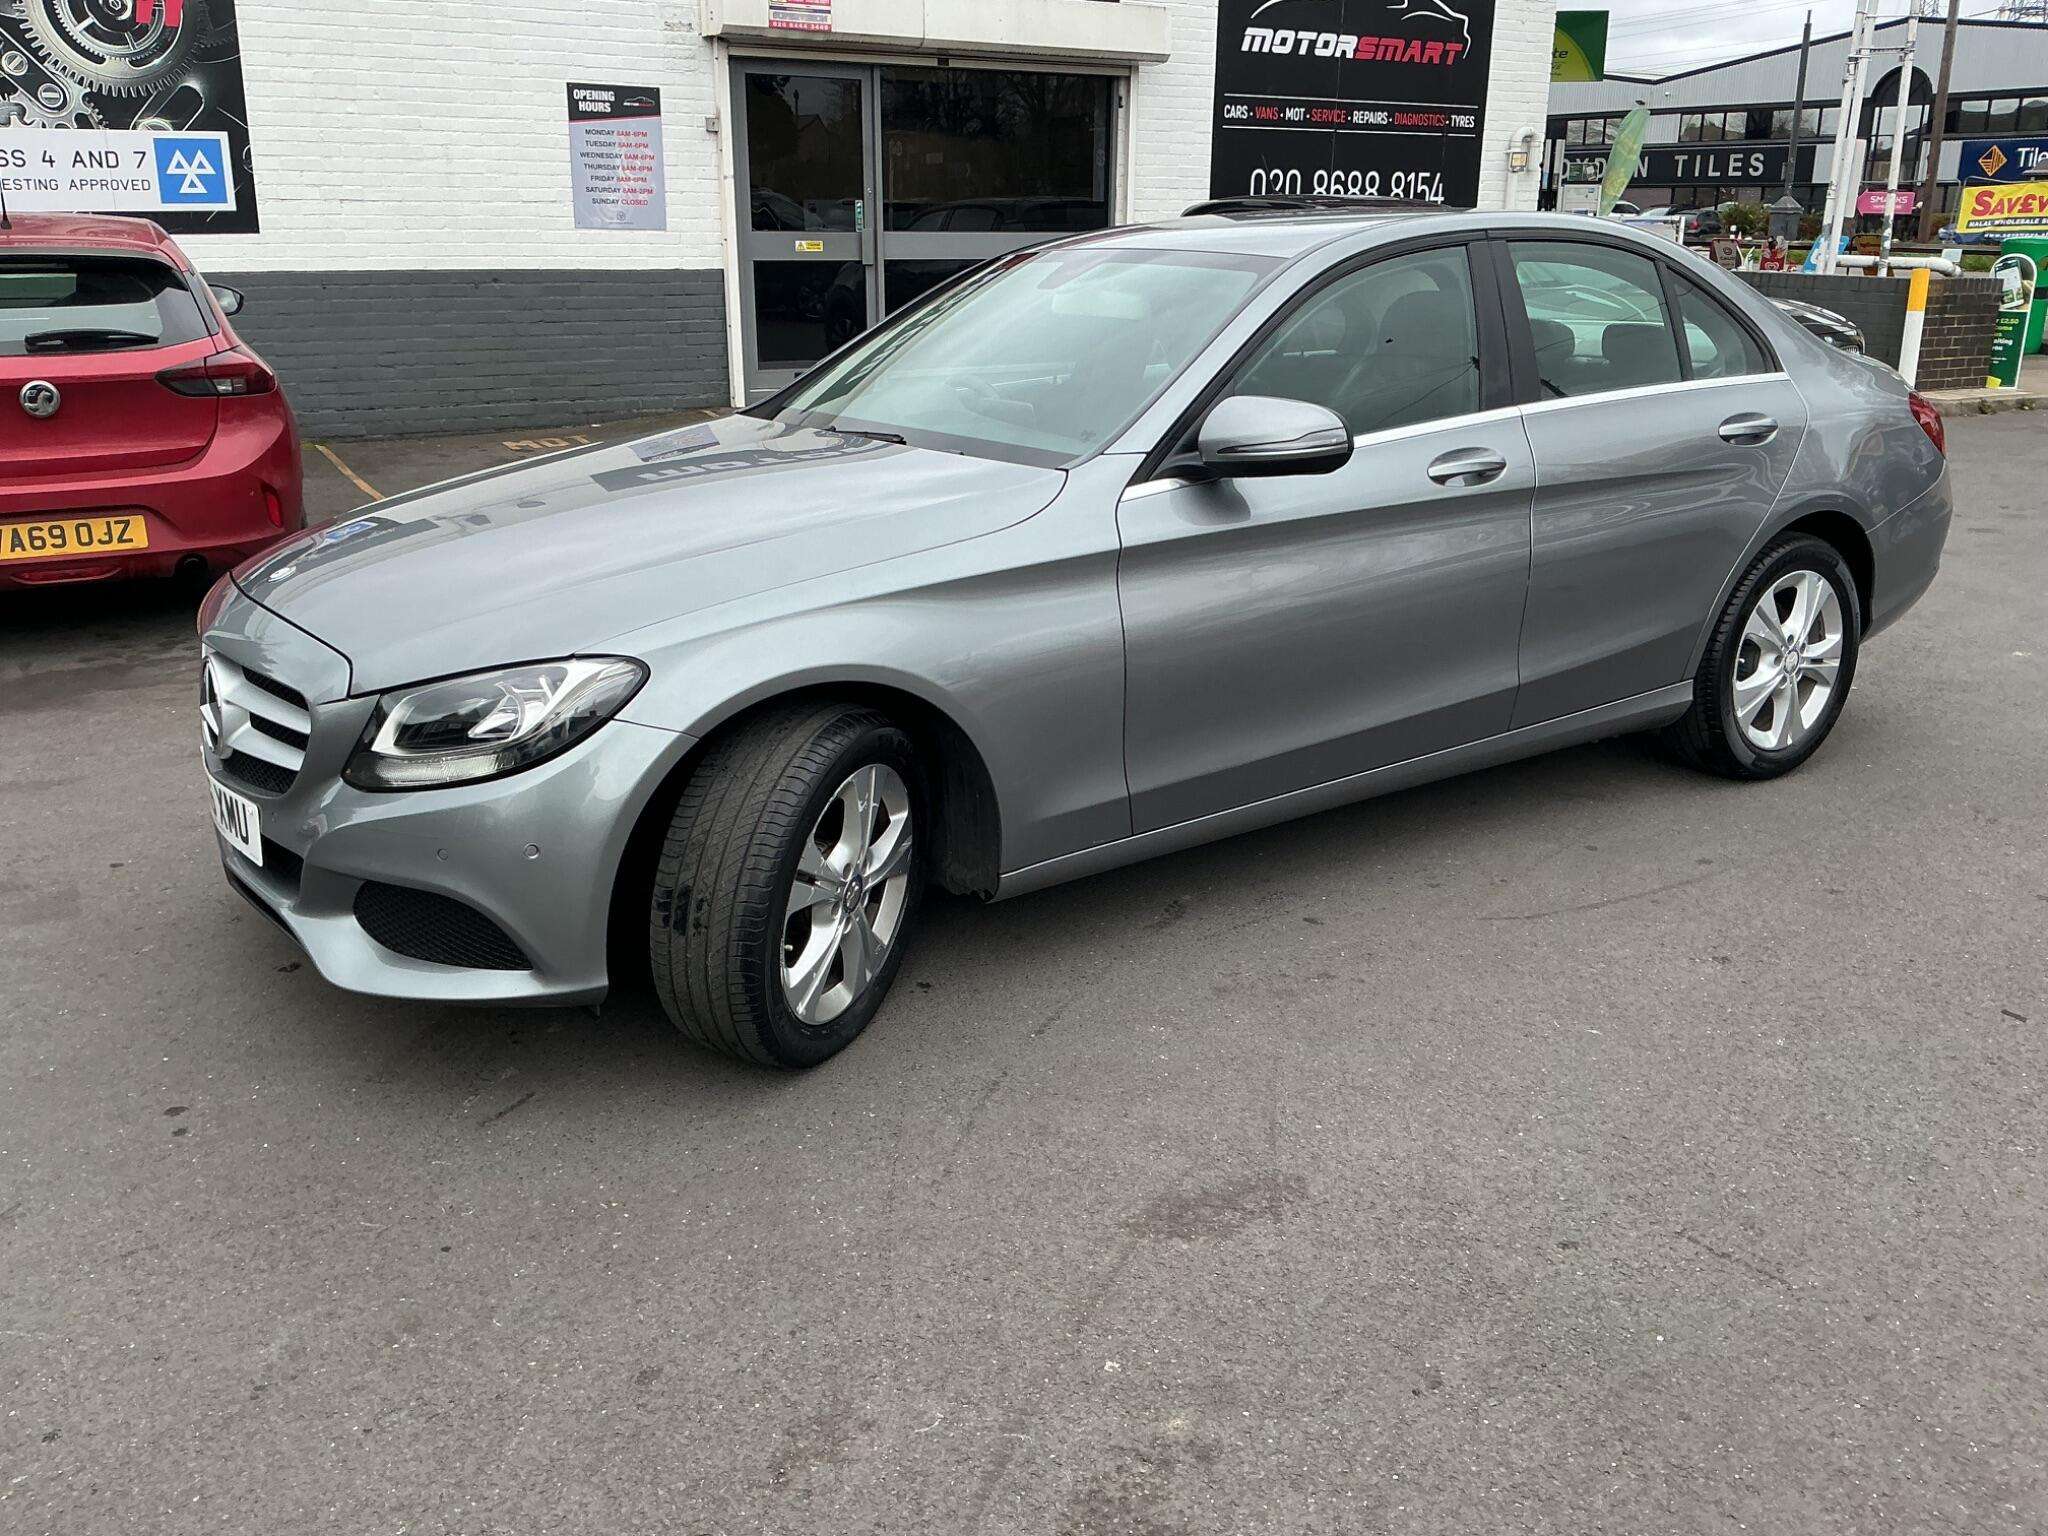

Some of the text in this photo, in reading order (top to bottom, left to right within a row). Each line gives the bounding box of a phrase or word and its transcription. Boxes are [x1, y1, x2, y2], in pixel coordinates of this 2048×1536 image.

[1241, 27, 1463, 65] MOTORSMART
[573, 89, 615, 101] OPENING
[578, 101, 611, 113] HOURS
[1224, 104, 1475, 128] CARS VANS MOT SERVICE REPAIRS DIAGNOSTICS TYRES
[585, 128, 614, 136] MONDAY
[585, 140, 616, 148] TUESDAY
[42, 150, 55, 168] 4
[72, 150, 119, 169] AND
[133, 151, 147, 169] 7
[580, 151, 622, 159] WEDNESDAY
[584, 163, 620, 171] THURSDAY
[1675, 153, 1764, 177] TILES
[69, 179, 151, 191] APPROVED
[586, 186, 620, 194] SATURDAY
[1250, 169, 1445, 204] 020 8688 8154
[592, 197, 619, 205] SUNDAY
[502, 434, 591, 450] MOT
[0, 519, 134, 553] A69 OJZ
